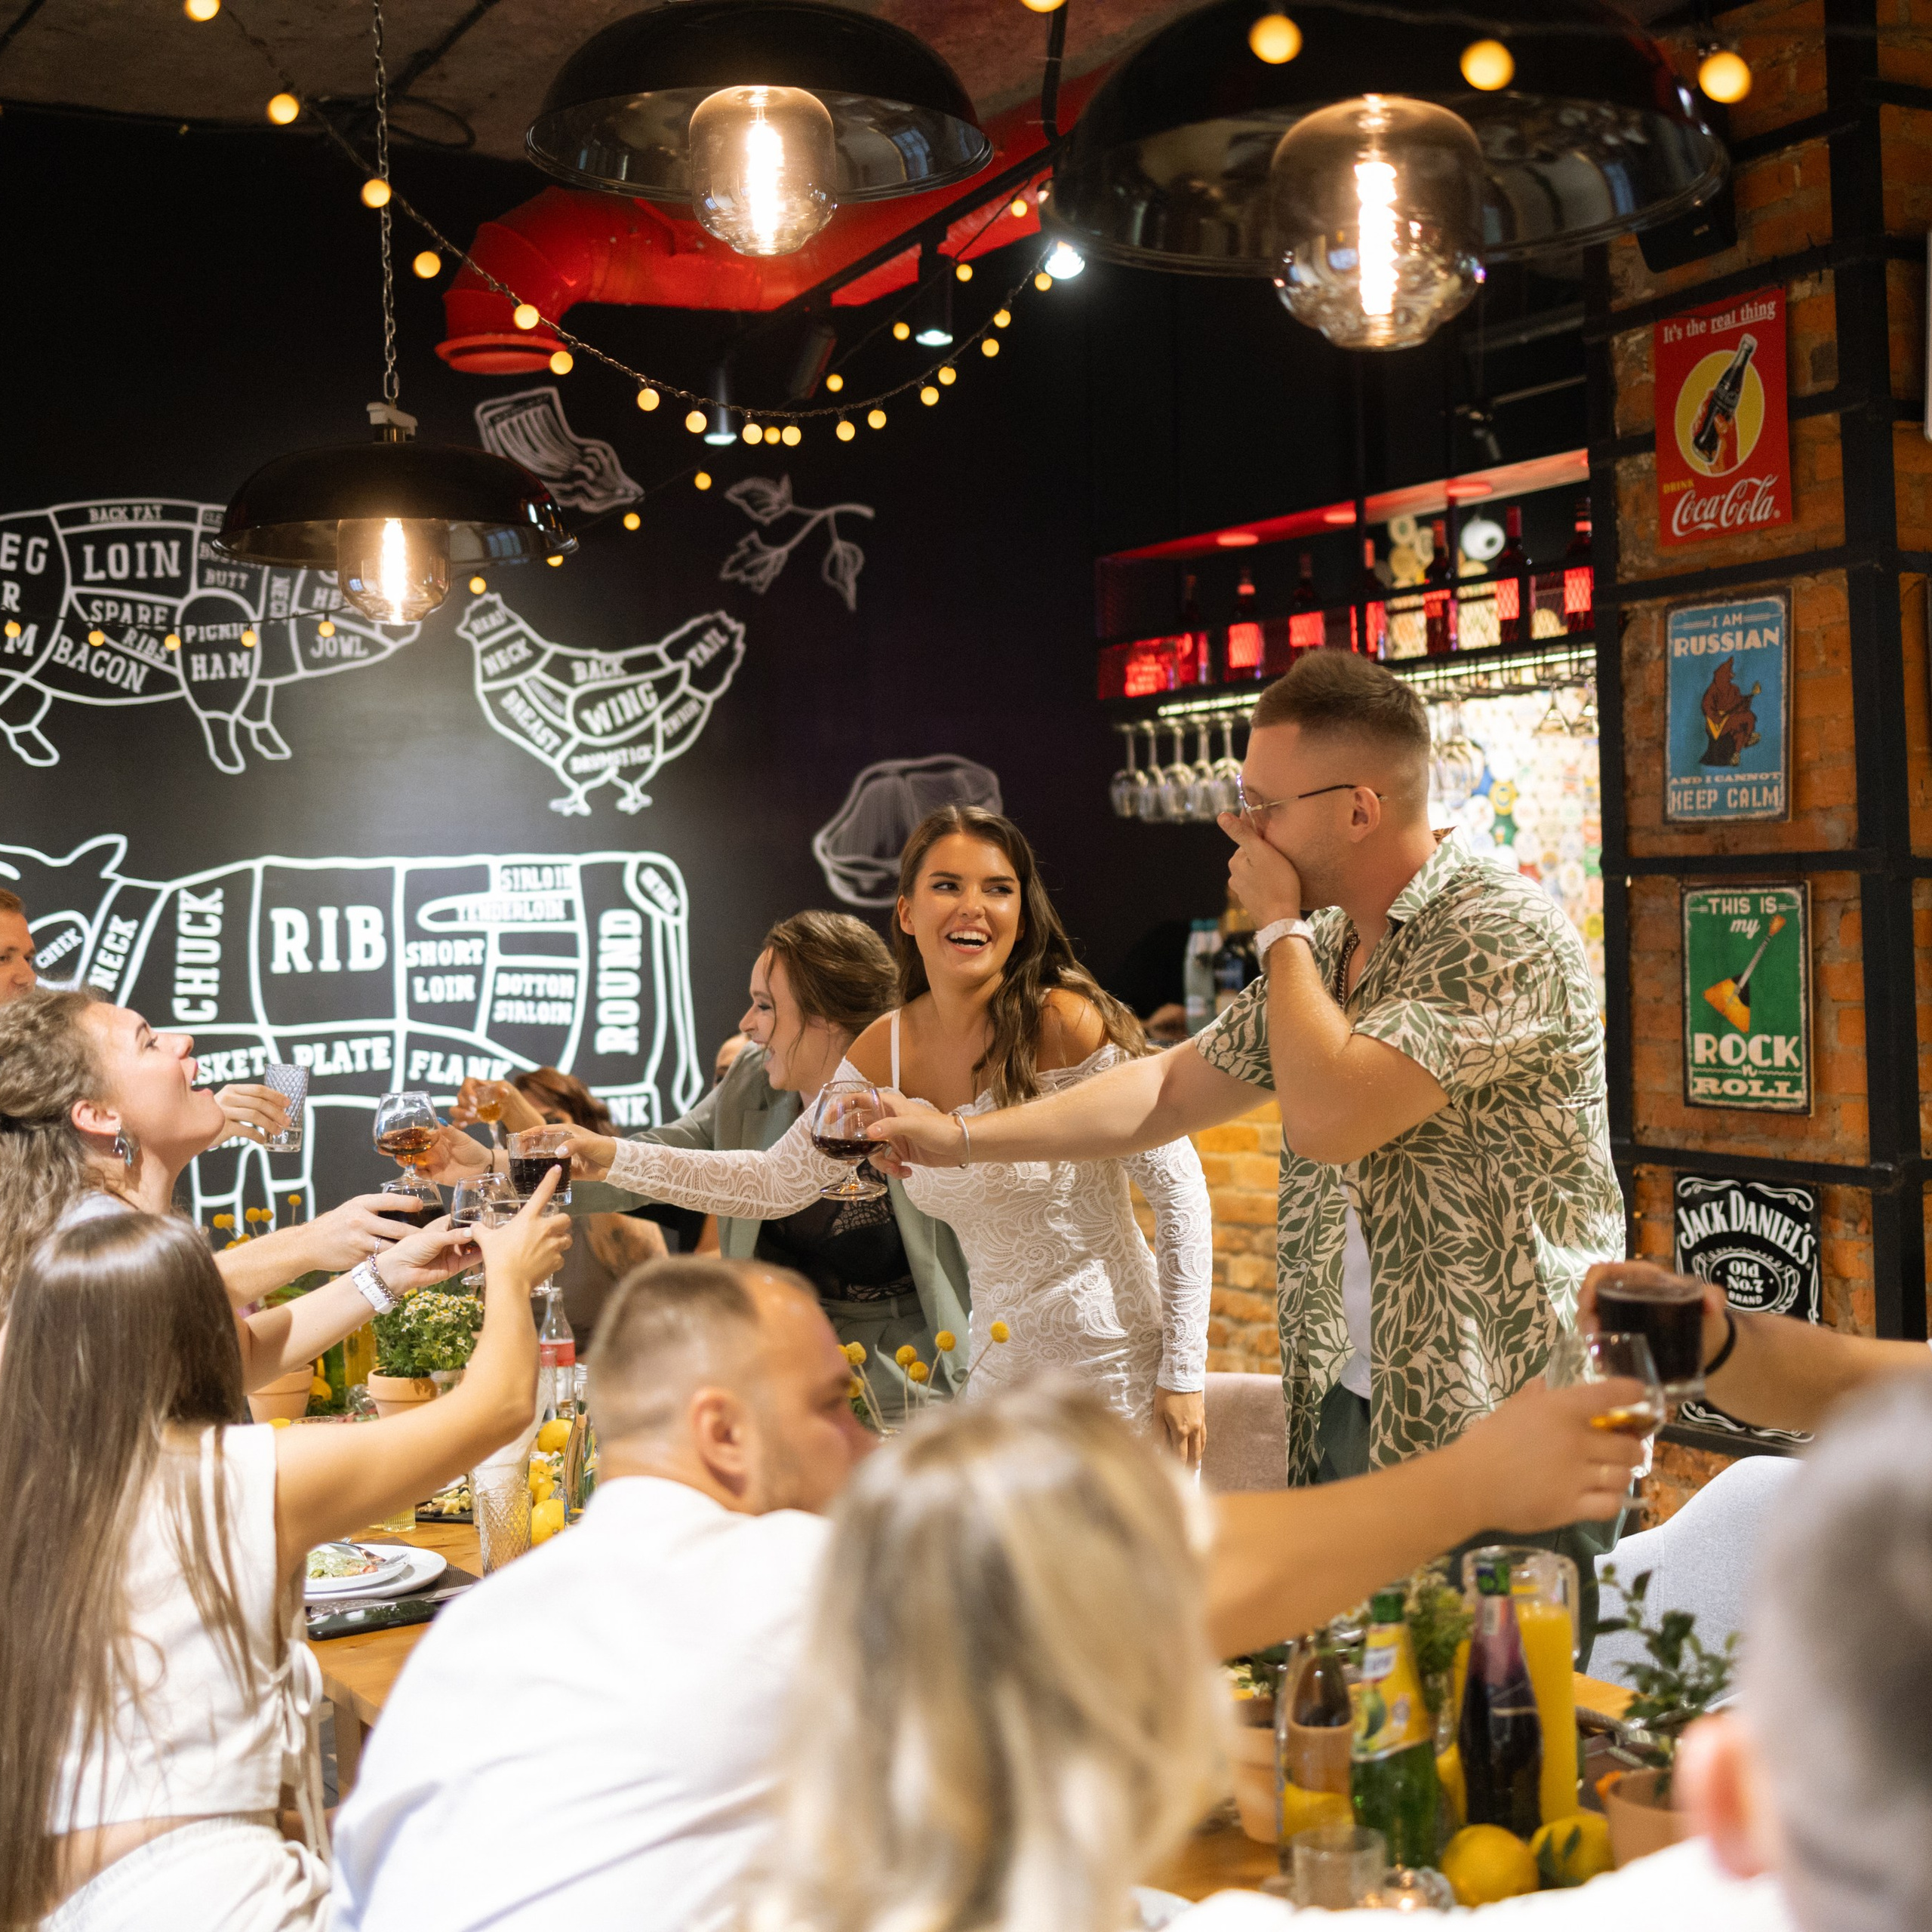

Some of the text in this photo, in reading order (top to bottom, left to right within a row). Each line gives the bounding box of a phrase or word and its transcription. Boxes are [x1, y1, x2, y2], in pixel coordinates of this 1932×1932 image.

[1663, 301, 1776, 344] It's the real thing
[1663, 478, 1694, 495] DRINK
[89, 504, 163, 523] BACK FAT
[0, 531, 49, 576] EG
[83, 540, 181, 581] LOIN
[204, 568, 249, 590] BUTT
[90, 599, 168, 632] SPARE
[1712, 612, 1743, 628] I AM
[122, 627, 171, 663] RIBS
[310, 635, 370, 658] JOWL
[483, 638, 534, 677] NECK
[685, 628, 730, 668] TAIL
[1673, 626, 1780, 658] RUSSIAN
[51, 634, 149, 694] BACON
[190, 651, 253, 681] HAM
[571, 657, 628, 683] BACK
[500, 689, 562, 753] BREAST
[580, 680, 660, 736] WING
[1670, 771, 1782, 785] AND I CANNOT
[1669, 785, 1780, 811] KEEP CALM
[1708, 896, 1777, 915] THIS IS
[269, 904, 387, 974] RIB
[1730, 917, 1761, 940] my
[35, 928, 84, 969] CHEEK
[88, 914, 139, 992] NECK
[171, 888, 223, 1022] CHUCK
[405, 939, 485, 968] SHORT
[412, 974, 476, 1003] LOIN
[495, 972, 576, 999] BOTTOM
[595, 909, 642, 1055] ROUND
[491, 998, 574, 1026] SIRLOIN
[191, 1045, 267, 1085] SKET
[292, 1036, 392, 1077] PLATE
[1694, 1032, 1801, 1068] ROCK
[408, 1050, 514, 1083] FLANK
[1742, 1063, 1758, 1078] n
[1693, 1076, 1803, 1100] ROLL
[1678, 1189, 1816, 1266] JACK DANIEL'S
[1728, 1260, 1759, 1278] Old
[1728, 1290, 1763, 1305] BRAND
